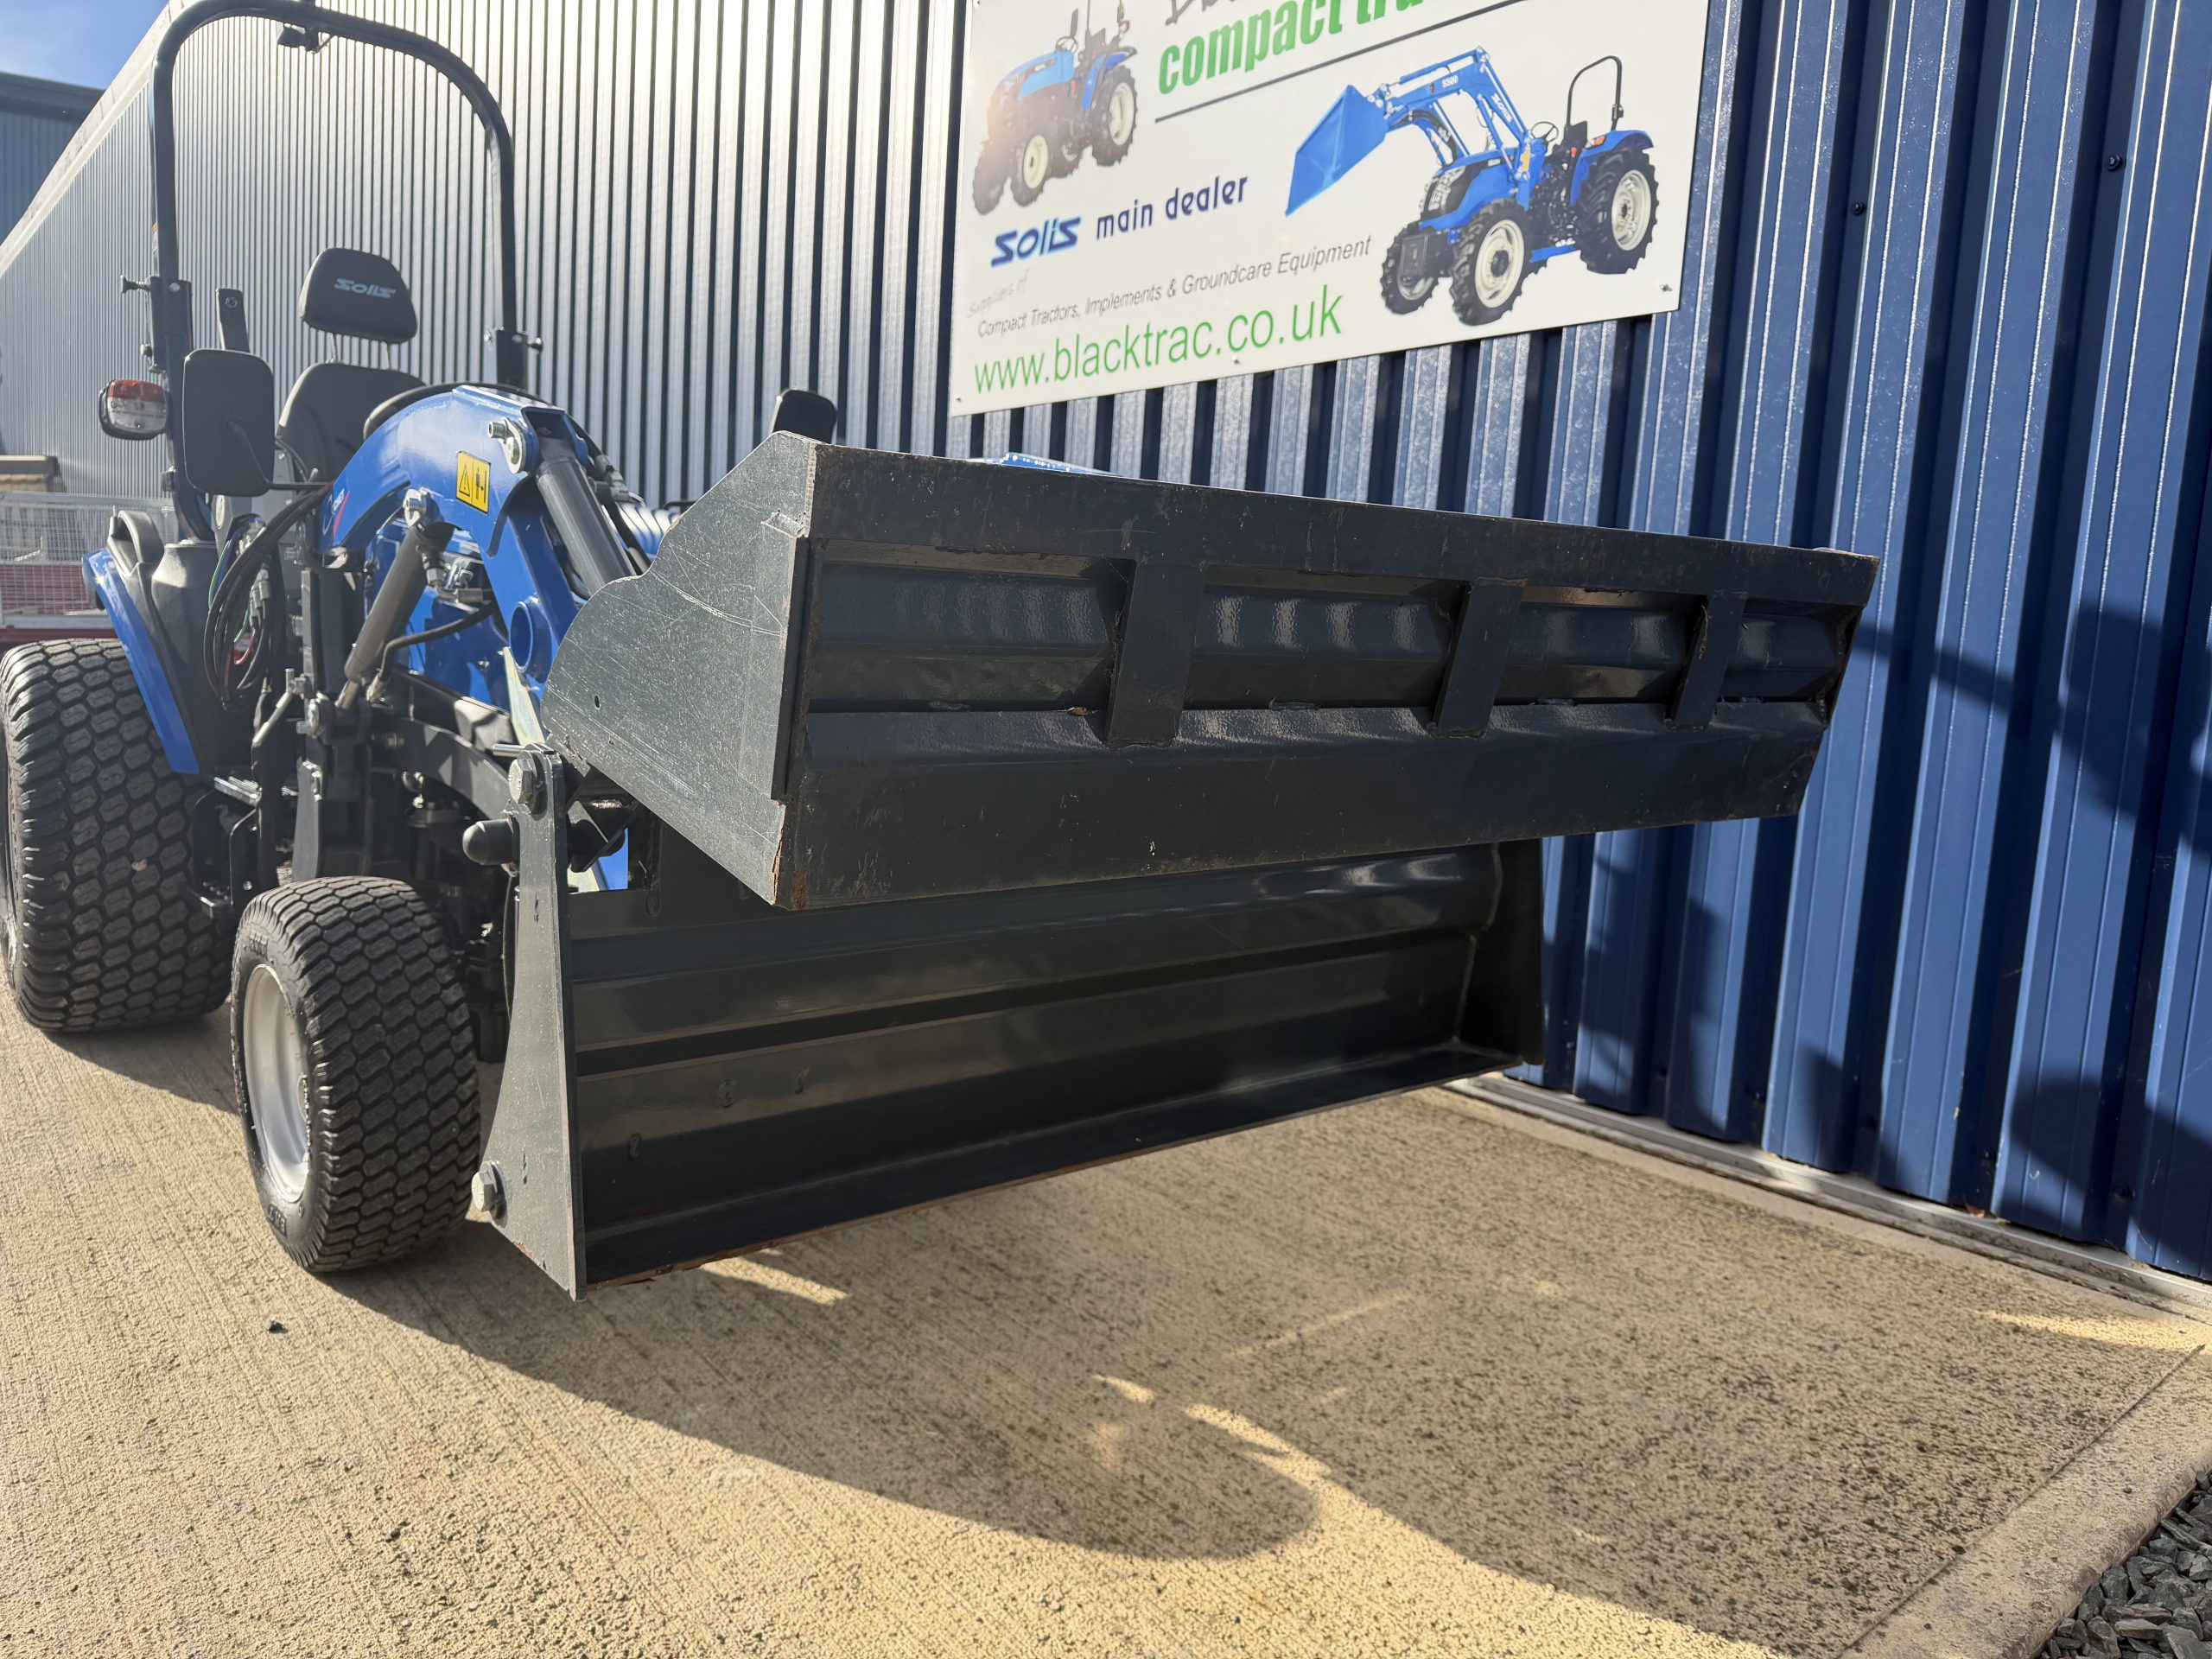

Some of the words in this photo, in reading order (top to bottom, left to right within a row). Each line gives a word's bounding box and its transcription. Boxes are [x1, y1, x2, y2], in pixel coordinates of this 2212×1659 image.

[1096, 199, 1154, 240] main
[1166, 175, 1249, 220] dealer
[977, 312, 1027, 338] Compact
[1030, 302, 1081, 327] Tractors,
[1084, 283, 1162, 316] Implements
[1166, 278, 1177, 298] &
[1181, 261, 1273, 295] Groundcare
[1276, 234, 1372, 275] Equipment
[974, 283, 1344, 394] www.blacktrac.co.uk
